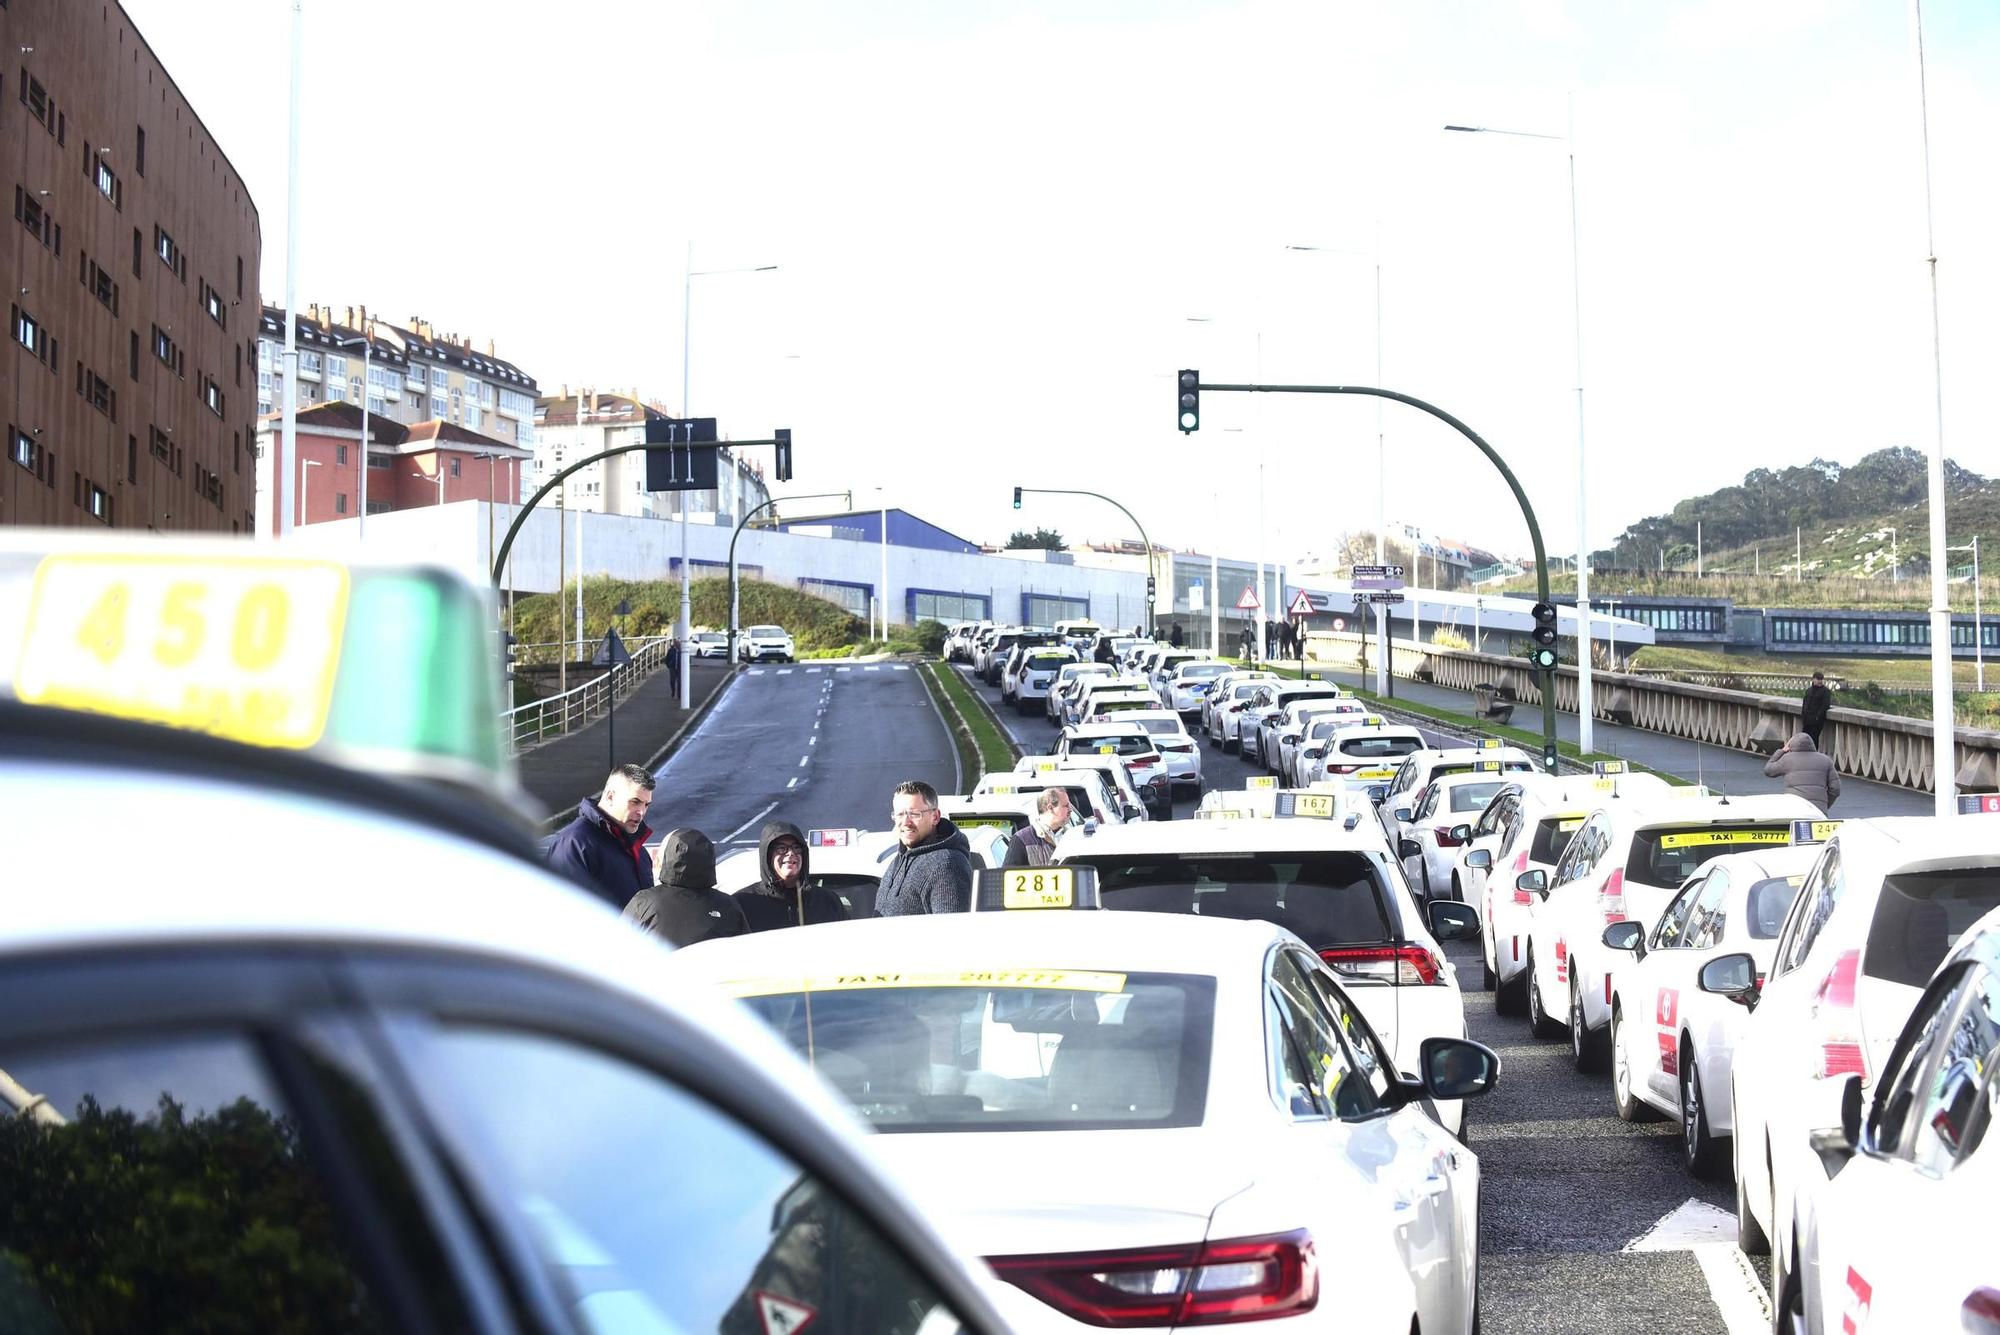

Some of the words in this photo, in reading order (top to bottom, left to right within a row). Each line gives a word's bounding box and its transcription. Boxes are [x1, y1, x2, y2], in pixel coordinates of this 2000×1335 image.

[75, 579, 293, 673] 450
[1302, 798, 1327, 809] 167
[1709, 833, 1734, 841] TAXI
[1751, 832, 1786, 841] 287777
[1015, 874, 1060, 892] 281
[1041, 895, 1065, 904] TAXI
[835, 973, 902, 984] TAXI
[959, 971, 1067, 983] 287777
